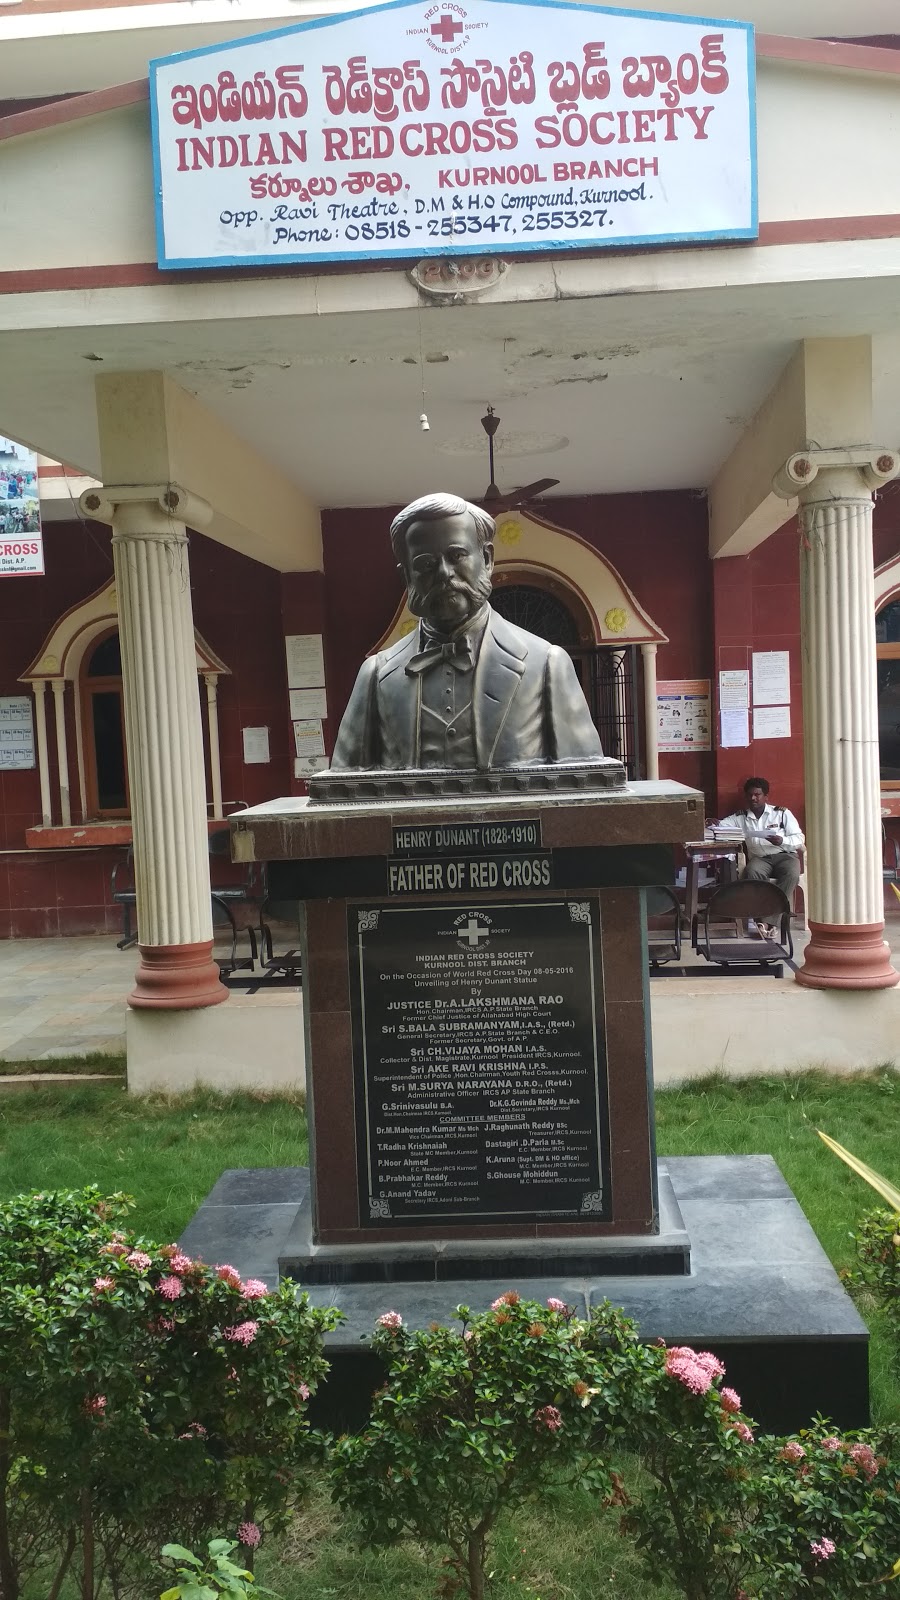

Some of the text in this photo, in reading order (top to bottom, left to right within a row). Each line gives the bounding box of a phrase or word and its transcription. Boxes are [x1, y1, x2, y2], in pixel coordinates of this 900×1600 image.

[424, 2, 468, 20] RED CROSS
[426, 38, 448, 54] KURNOOL
[450, 44, 462, 54] DIST
[170, 64, 308, 130] ఇండియన్
[175, 106, 714, 172] INDIAN RED CROSS SOCIETY
[438, 156, 659, 188] KURNOOL BRANCH
[220, 210, 264, 228] Opp.
[270, 202, 319, 222] Ravi
[416, 196, 445, 214] D.M
[452, 196, 464, 210] &
[468, 194, 494, 210] H.O
[522, 209, 614, 232] 255327.
[396, 824, 536, 848] HENRY DUNANT (1828-1910)
[389, 860, 550, 892] FATHER OF RED CROSS
[454, 912, 492, 926] RED CROSS
[471, 988, 482, 996] By
[387, 995, 563, 1010] JUSTICE Dr.A.LAKSHMANA RAO
[382, 1025, 395, 1033] Sri
[399, 1024, 436, 1032] S.BALA
[548, 1020, 575, 1028] (Retd.)
[411, 1048, 424, 1056] Sri
[427, 1046, 481, 1055] CH.VIJAYA
[484, 1045, 522, 1053] MOHAN
[411, 1065, 424, 1074] Sri
[479, 1062, 526, 1071] KRISHNA
[408, 1082, 454, 1091] M.SURYA
[457, 1080, 512, 1089] NARAYANA
[382, 1102, 438, 1110] G.Srinivasulu
[484, 1123, 530, 1132] J.Raghunath
[532, 1122, 554, 1130] Reddy
[486, 1140, 519, 1148] Dastagiri
